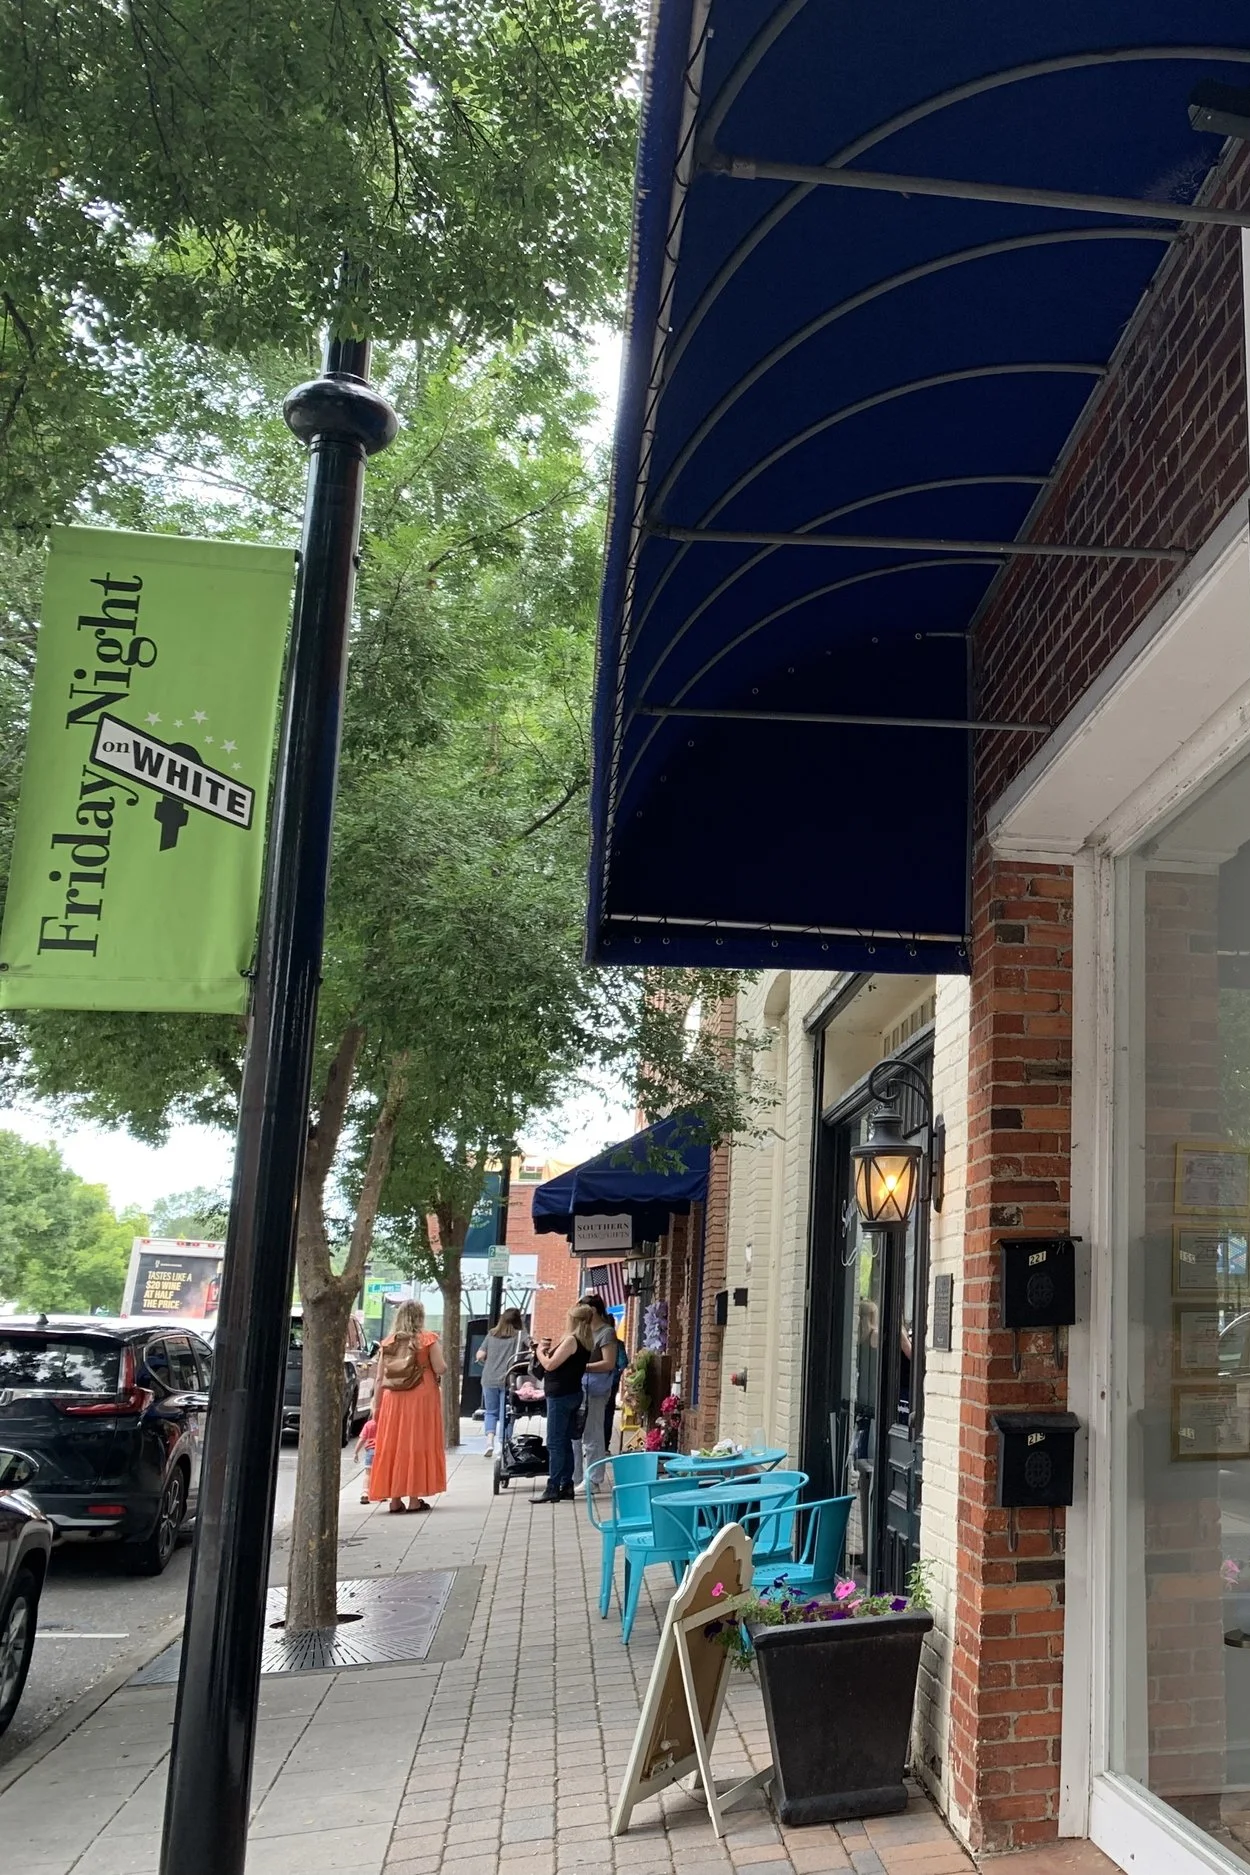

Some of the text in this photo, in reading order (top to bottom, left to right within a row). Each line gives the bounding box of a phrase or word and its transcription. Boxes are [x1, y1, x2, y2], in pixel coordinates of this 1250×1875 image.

[36, 572, 157, 957] Friday Night
[102, 737, 249, 819] on WHITE
[577, 1223, 629, 1231] SOUTHERN
[1030, 1251, 1046, 1265] 221
[148, 1271, 192, 1282] TASTES LIKE A
[146, 1280, 181, 1291] $20 WINE
[143, 1290, 174, 1299] AT HALF
[143, 1299, 157, 1308] THE
